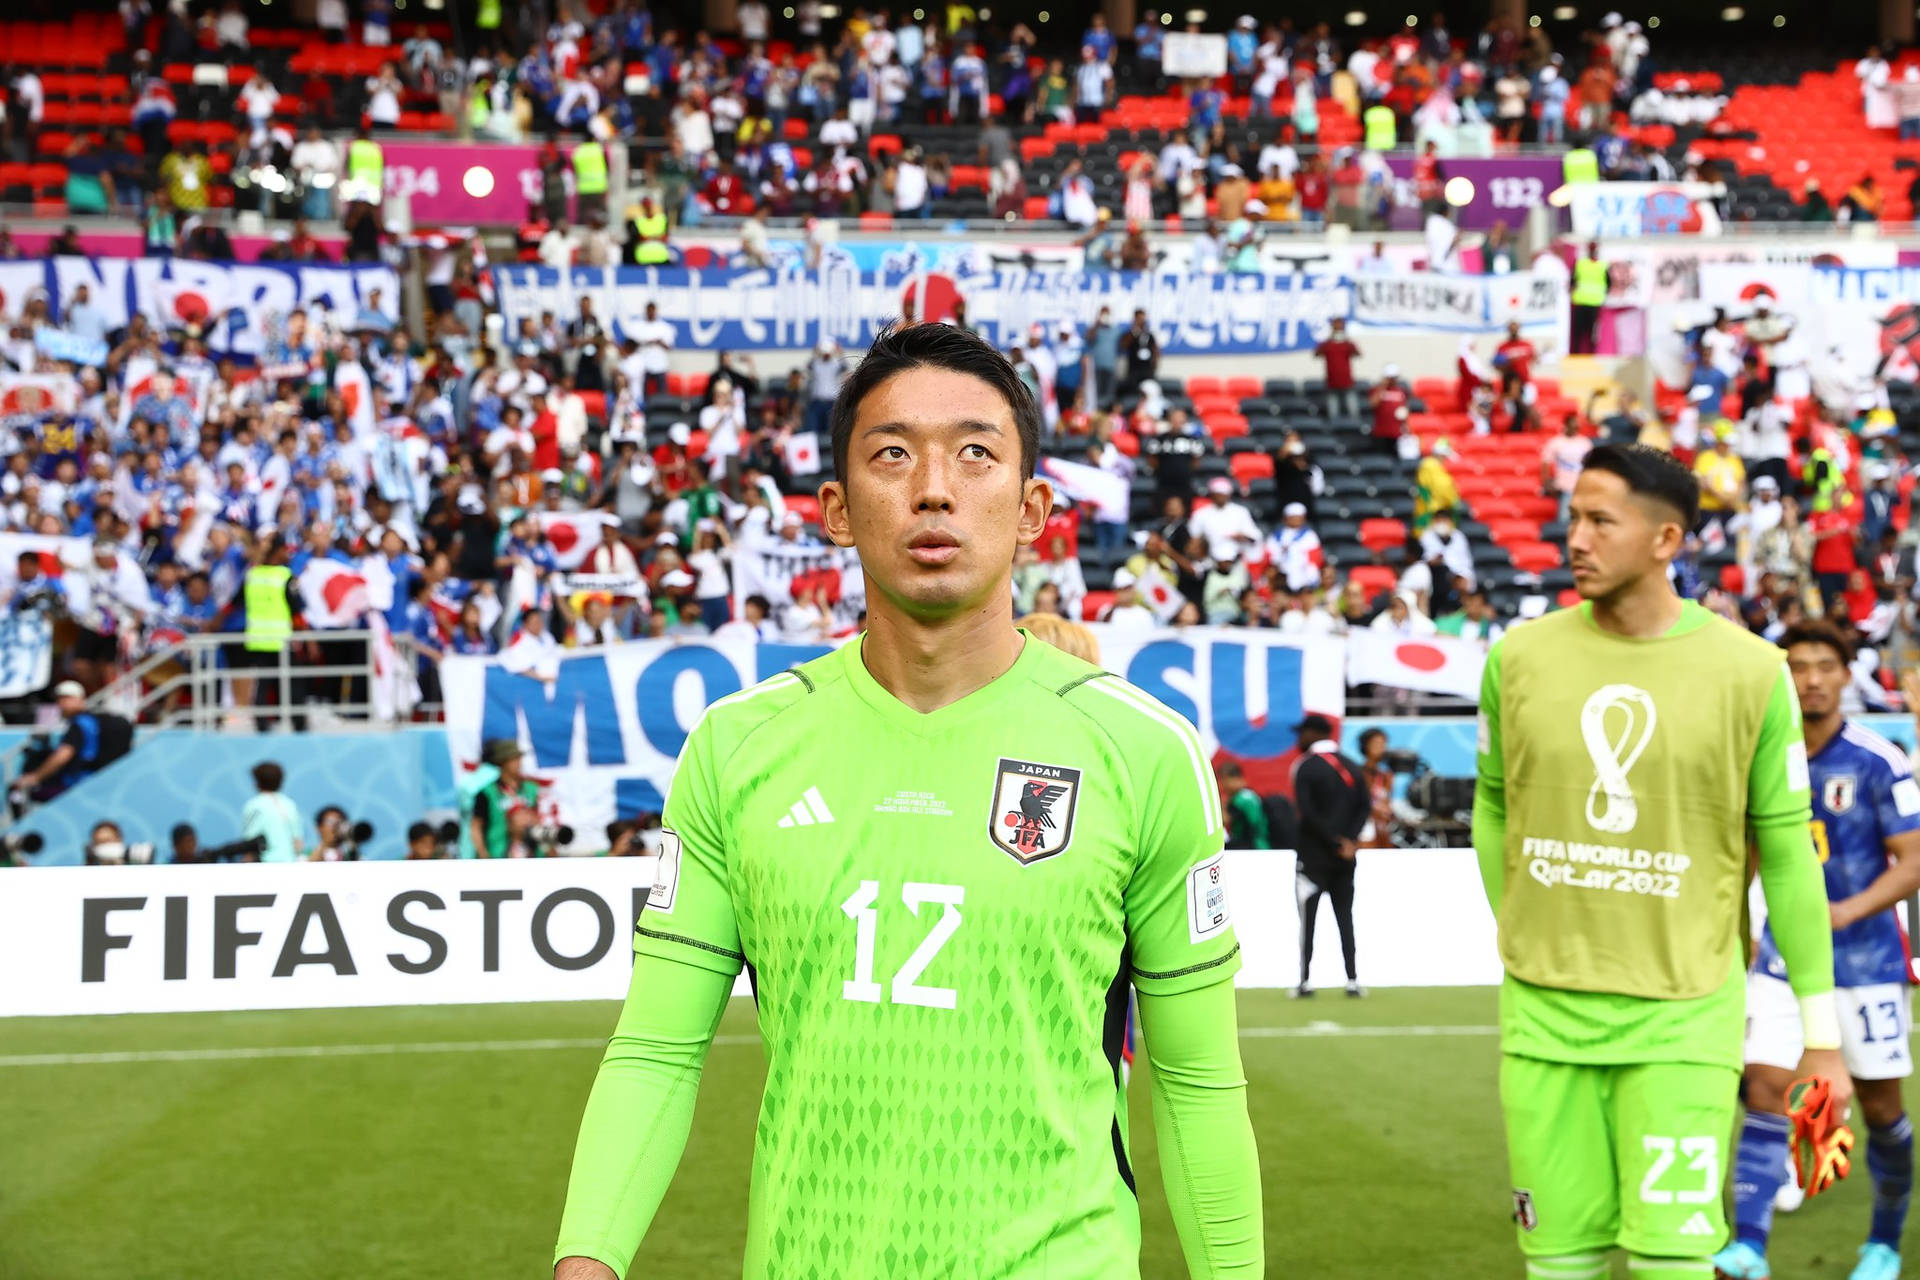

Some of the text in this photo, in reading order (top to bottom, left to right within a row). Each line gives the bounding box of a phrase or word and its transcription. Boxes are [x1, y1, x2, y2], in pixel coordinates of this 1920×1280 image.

[1489, 177, 1544, 208] 132
[1019, 764, 1061, 778] JAPAN
[1009, 829, 1045, 849] JFA
[1523, 836, 1692, 875] FIFA WORLD CUP
[81, 892, 358, 983] FIFA
[840, 879, 965, 1010] 12
[1858, 1001, 1901, 1043] 13
[1640, 1135, 1718, 1204] 23
